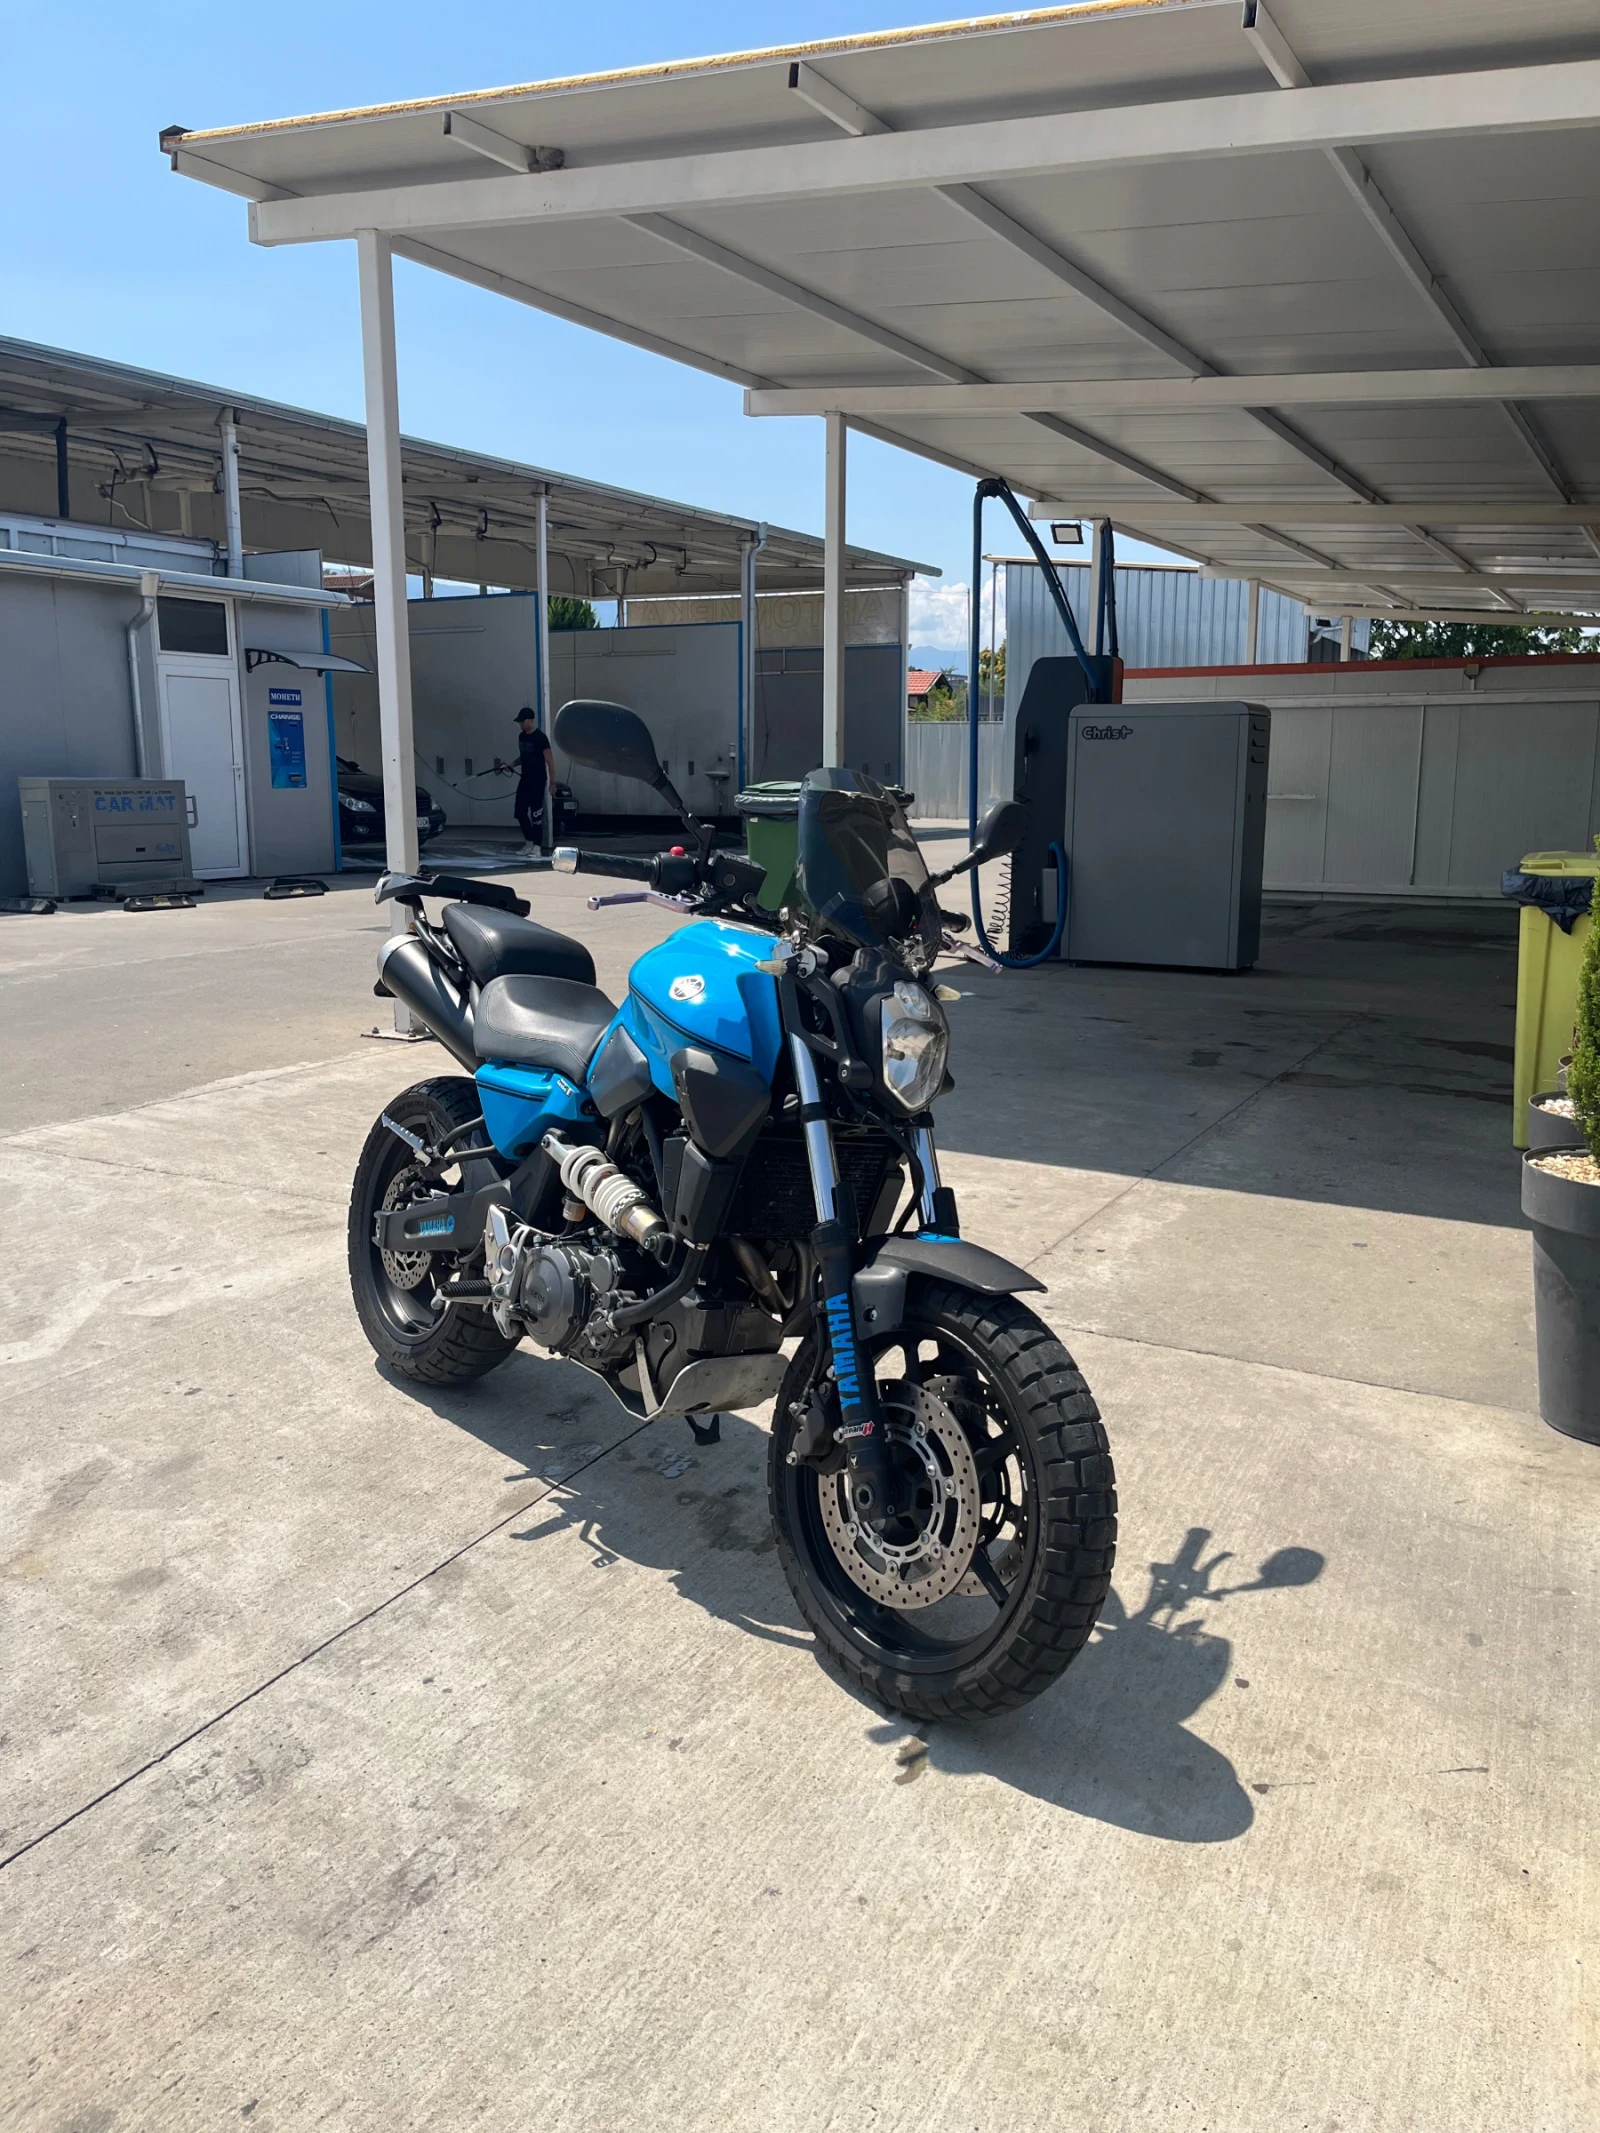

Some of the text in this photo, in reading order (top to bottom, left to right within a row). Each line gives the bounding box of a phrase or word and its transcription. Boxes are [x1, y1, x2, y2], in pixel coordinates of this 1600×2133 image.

[270, 692, 301, 701] МОНЕТИ
[1082, 725, 1133, 740] Christ
[94, 796, 134, 812] CAR
[419, 1218, 446, 1235] YAMAHA
[825, 1292, 861, 1411] YAMAHA
